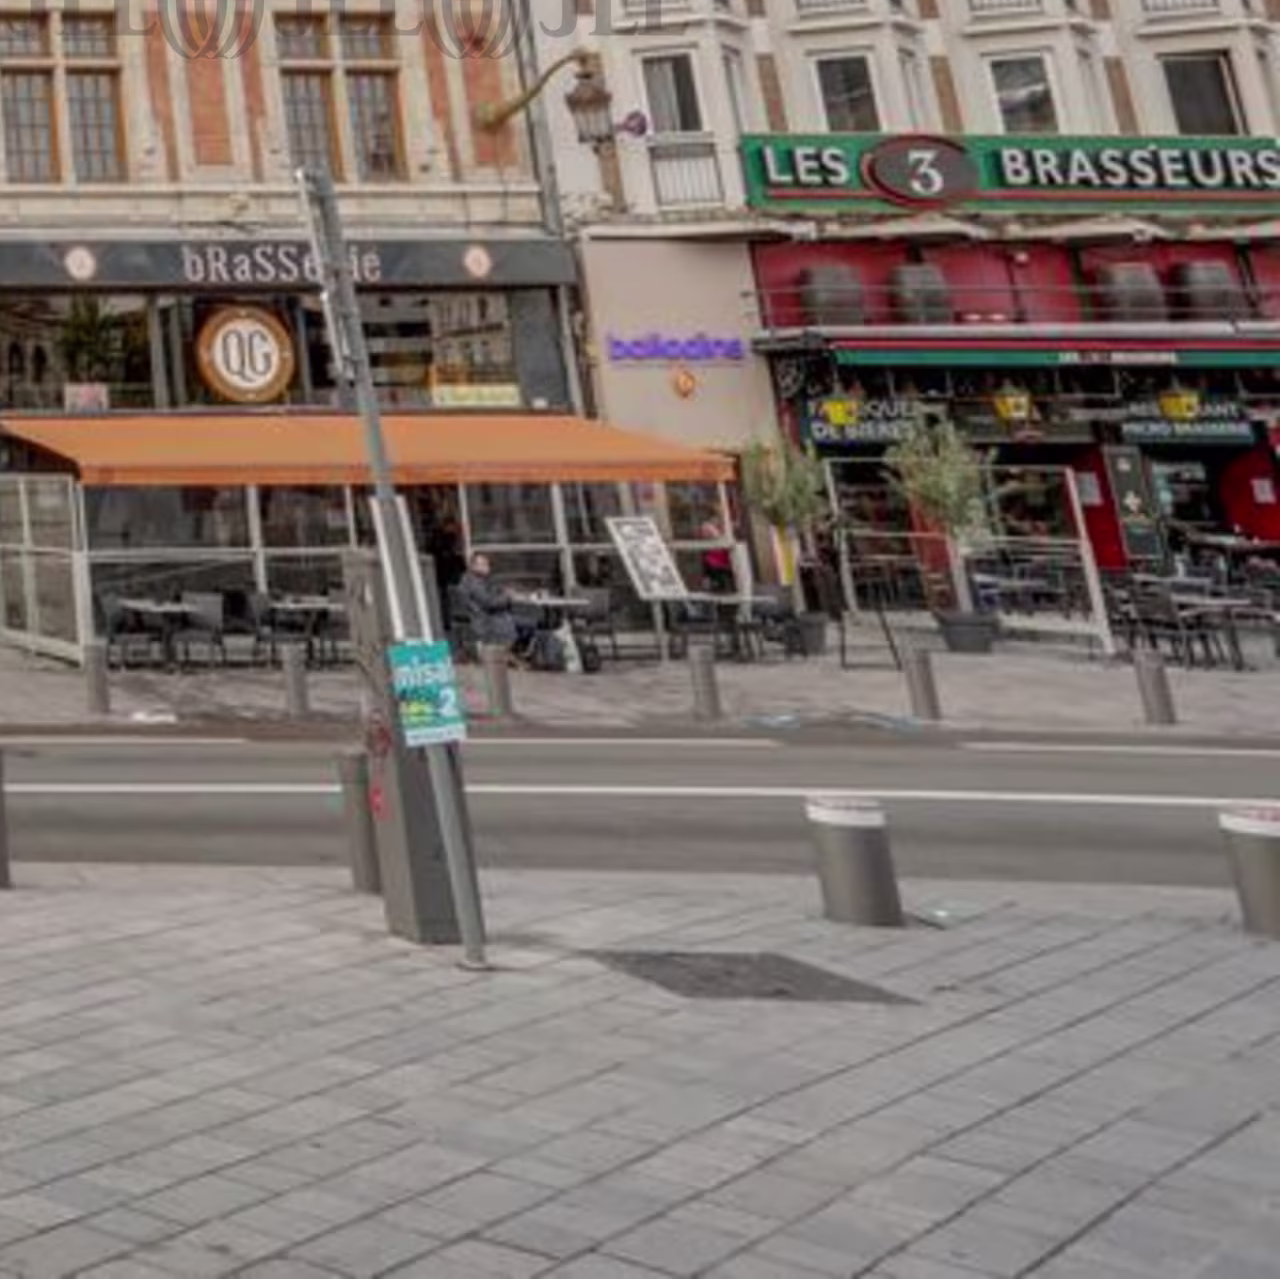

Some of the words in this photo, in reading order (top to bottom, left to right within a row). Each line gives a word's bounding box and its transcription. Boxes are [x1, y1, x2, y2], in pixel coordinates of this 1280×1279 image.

[762, 145, 850, 185] LES
[907, 149, 944, 197] 3
[1001, 146, 1280, 187] BRASSEURS
[181, 245, 381, 283] bRaSSeie
[222, 328, 272, 383] QG
